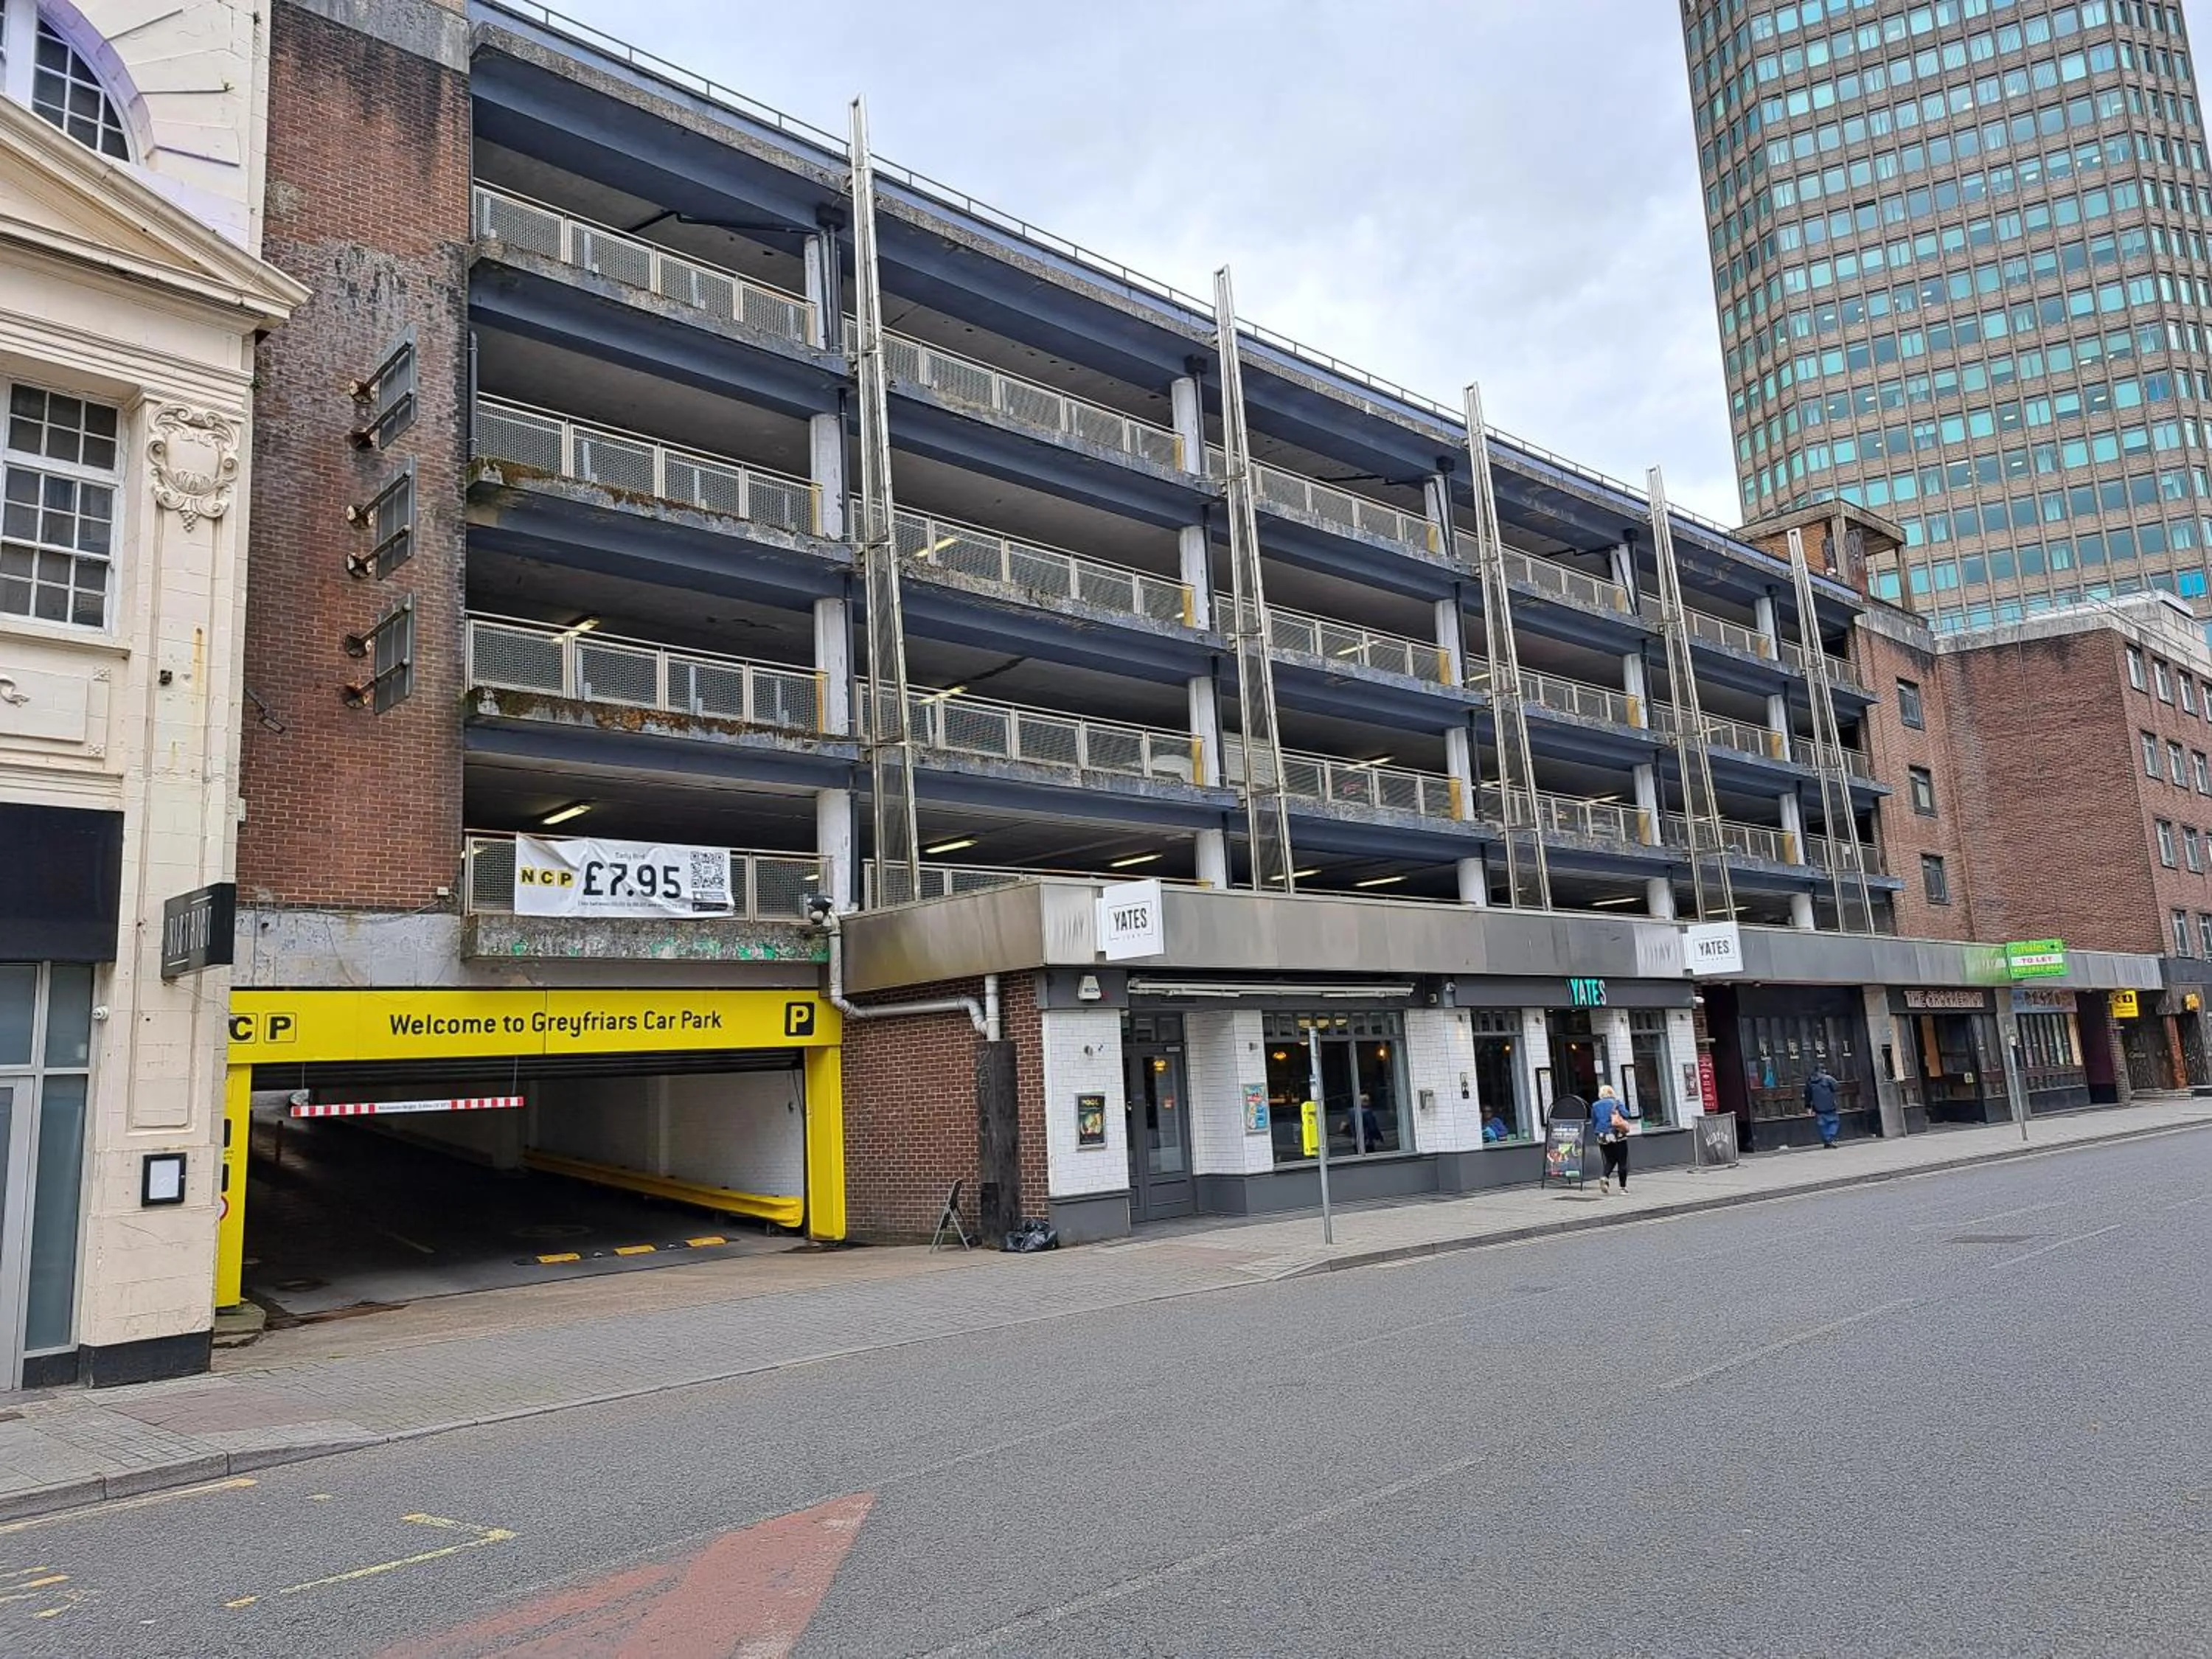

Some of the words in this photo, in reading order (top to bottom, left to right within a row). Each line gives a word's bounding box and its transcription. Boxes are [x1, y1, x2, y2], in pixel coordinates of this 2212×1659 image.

[521, 869, 572, 886] NCP
[582, 860, 682, 900] £7.95
[1113, 908, 1147, 931] YATES
[1698, 940, 1730, 956] YATES
[1570, 978, 1607, 1006] YATES
[389, 1012, 496, 1035] Welcome
[503, 1015, 525, 1033] to
[531, 1011, 637, 1037] Greyfriars
[644, 1010, 675, 1030] Car
[681, 1009, 722, 1029] Park
[789, 1005, 810, 1033] P
